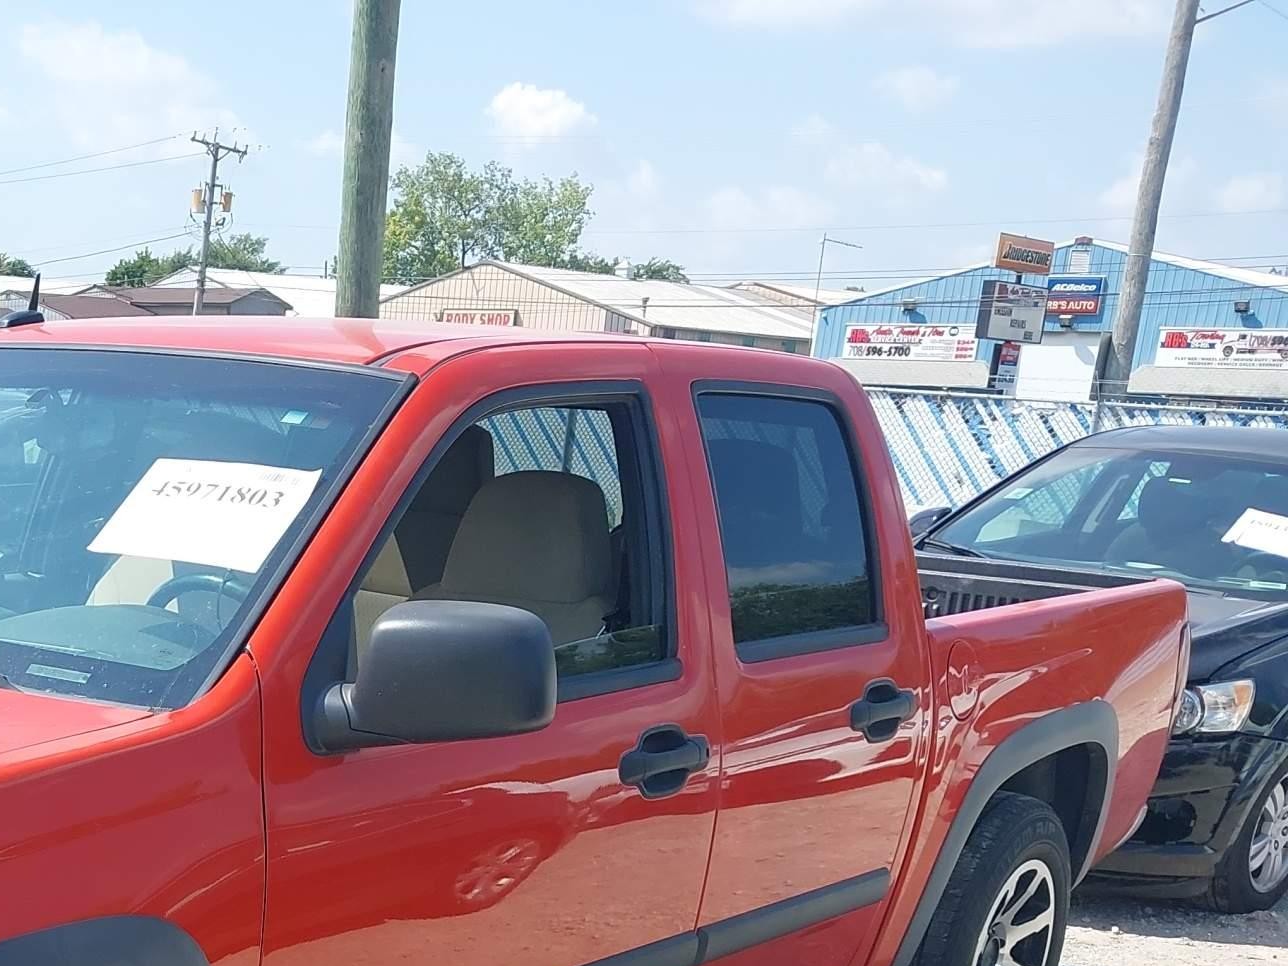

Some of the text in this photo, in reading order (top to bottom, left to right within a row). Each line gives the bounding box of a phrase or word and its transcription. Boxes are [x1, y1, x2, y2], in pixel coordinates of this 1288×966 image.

[1003, 243, 1051, 266] BRIDGESTONE
[1051, 283, 1097, 292] ACDelco
[1067, 301, 1095, 310] AUTO
[480, 313, 511, 326] SHOP
[152, 480, 285, 508] 45971803
